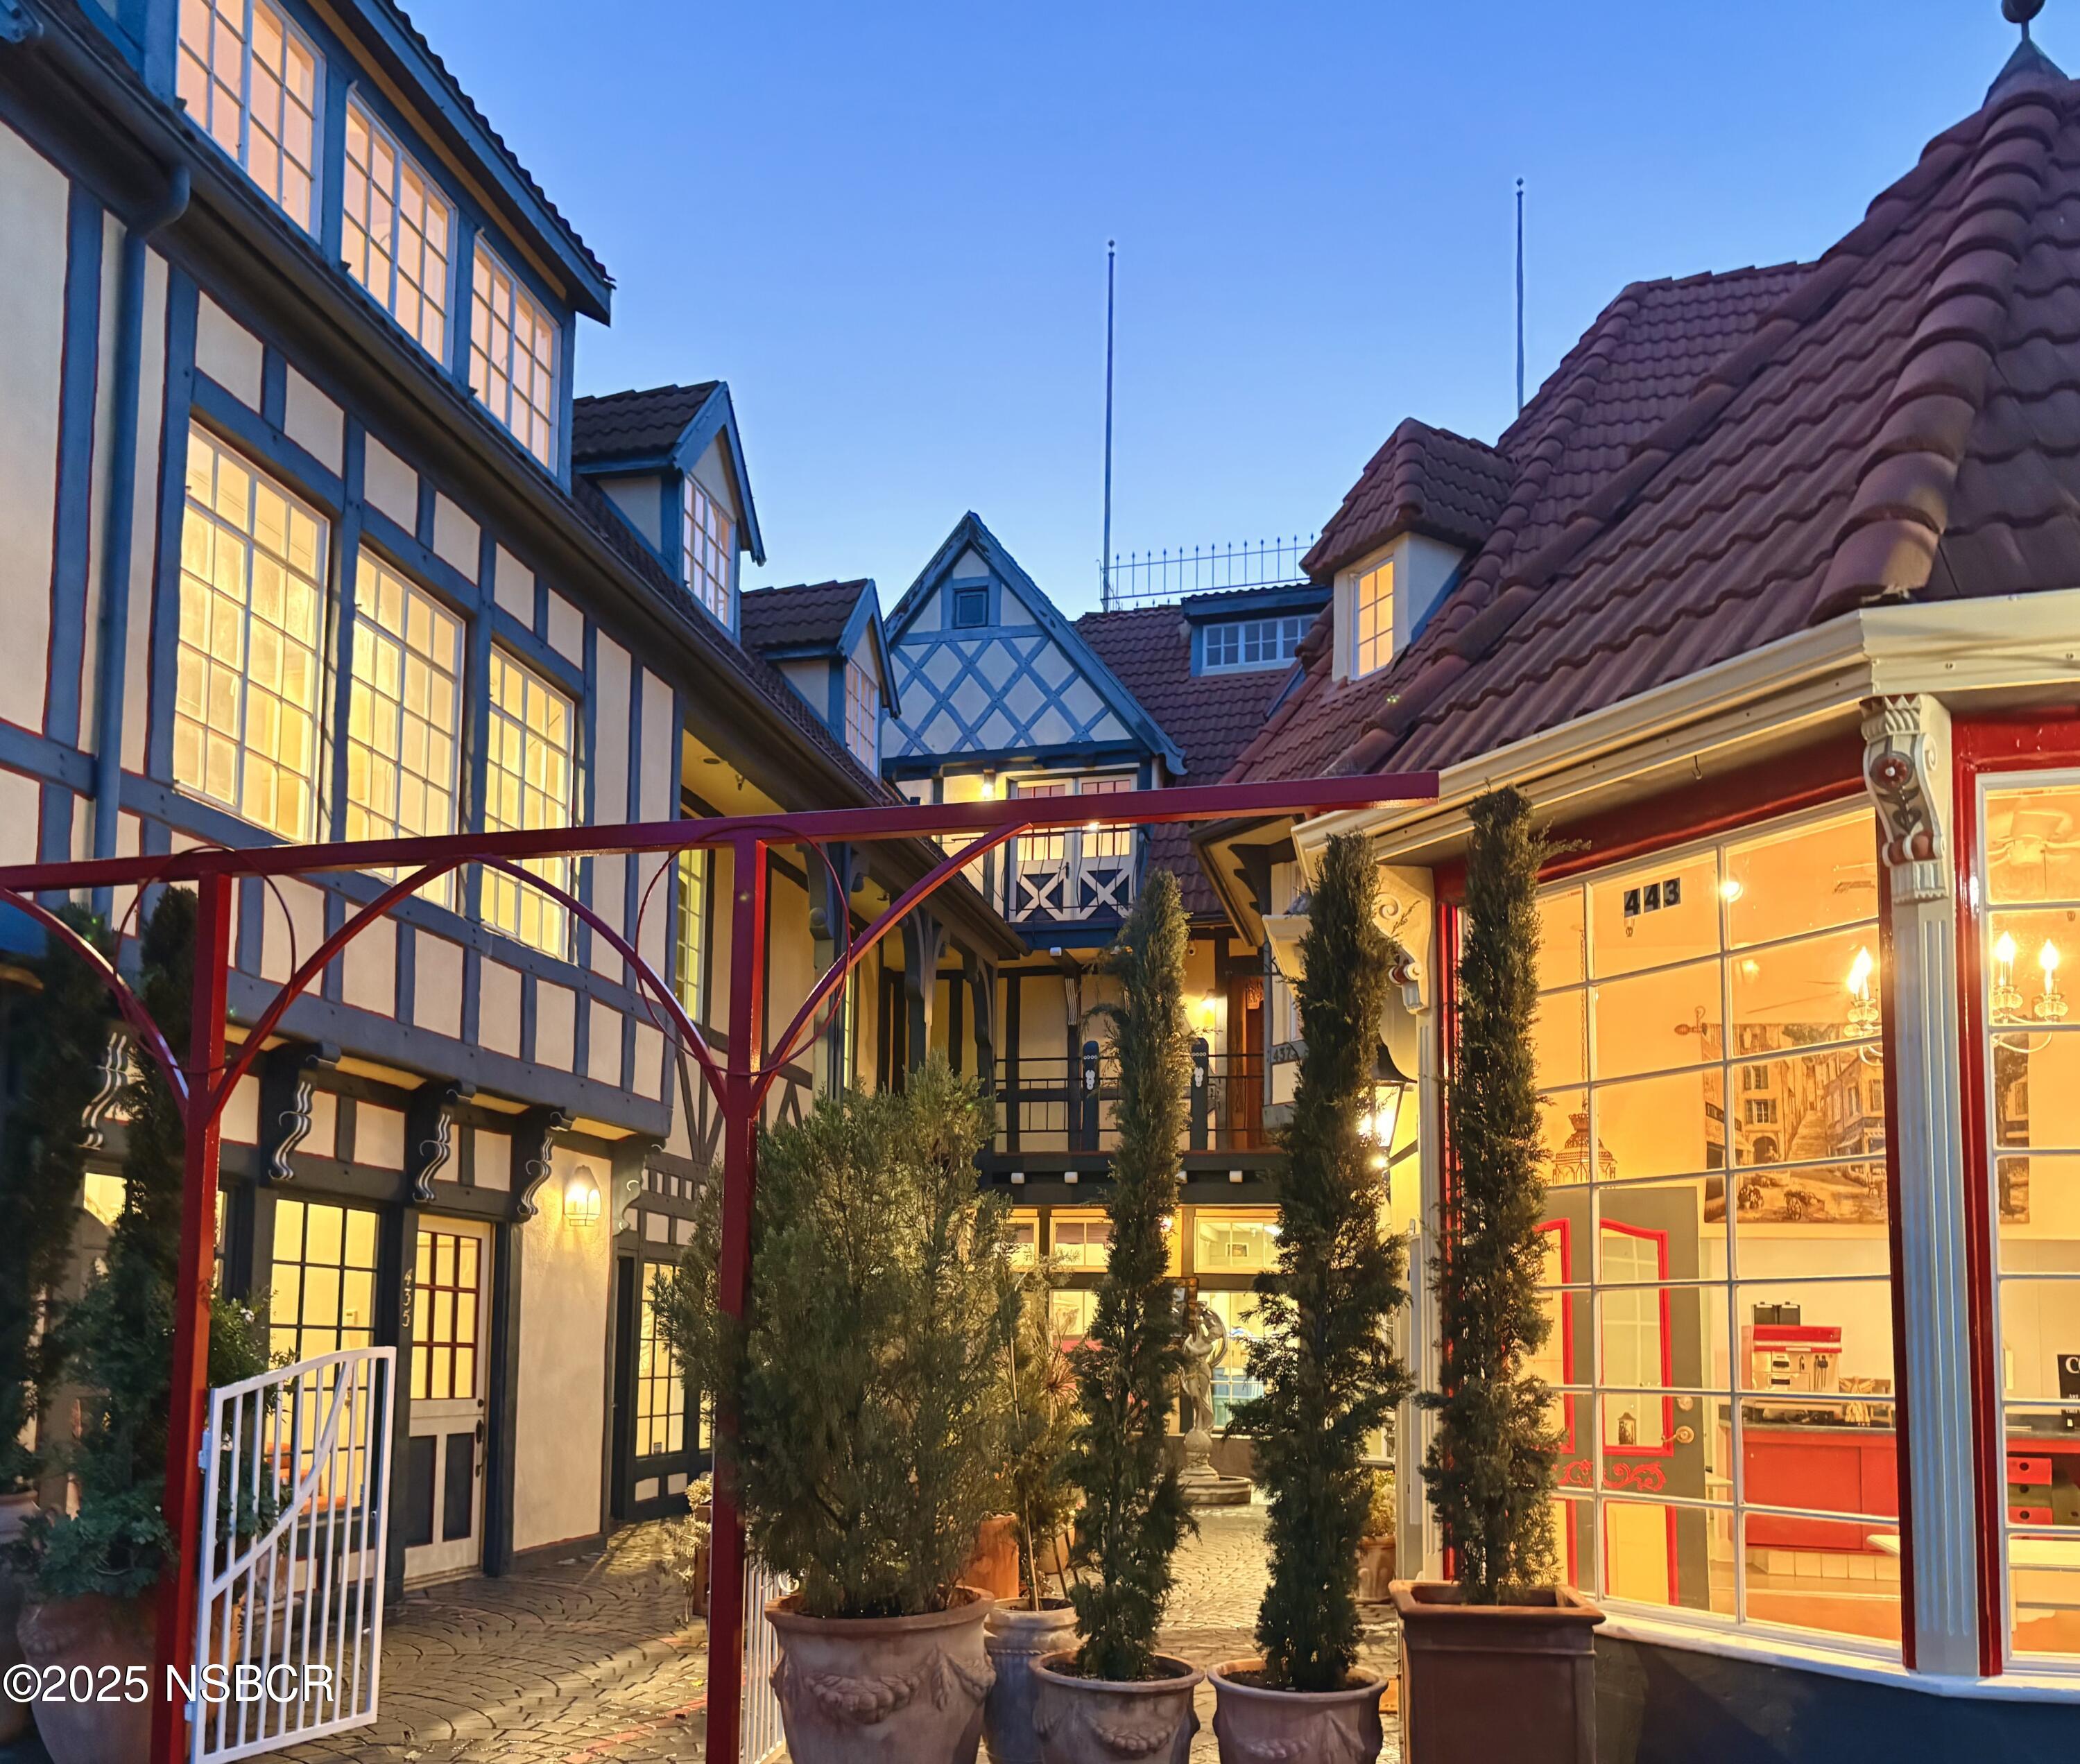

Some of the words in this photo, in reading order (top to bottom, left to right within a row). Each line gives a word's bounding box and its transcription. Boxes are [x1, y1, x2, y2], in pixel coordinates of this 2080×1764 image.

[1625, 879, 1679, 915] 443
[402, 1268, 413, 1327] 435
[2065, 1357, 2080, 1374] C
